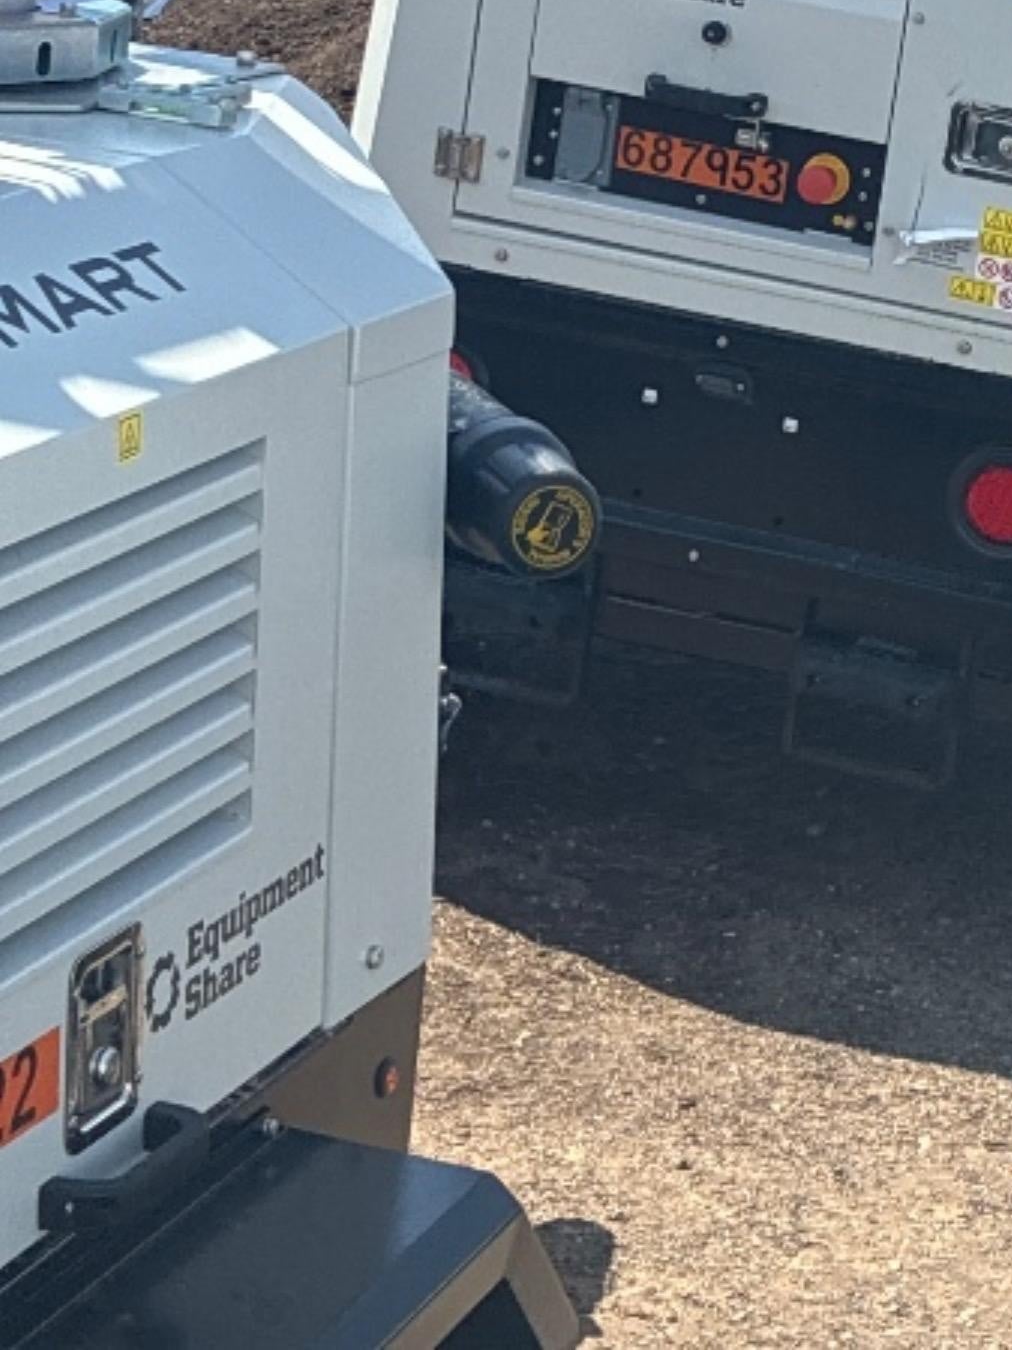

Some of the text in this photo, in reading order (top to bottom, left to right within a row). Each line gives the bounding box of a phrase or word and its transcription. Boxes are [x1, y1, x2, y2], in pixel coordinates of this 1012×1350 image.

[622, 129, 784, 196] 687953
[185, 842, 325, 970] Equipment
[184, 942, 262, 1021] Share
[0, 1044, 37, 1136] 2
